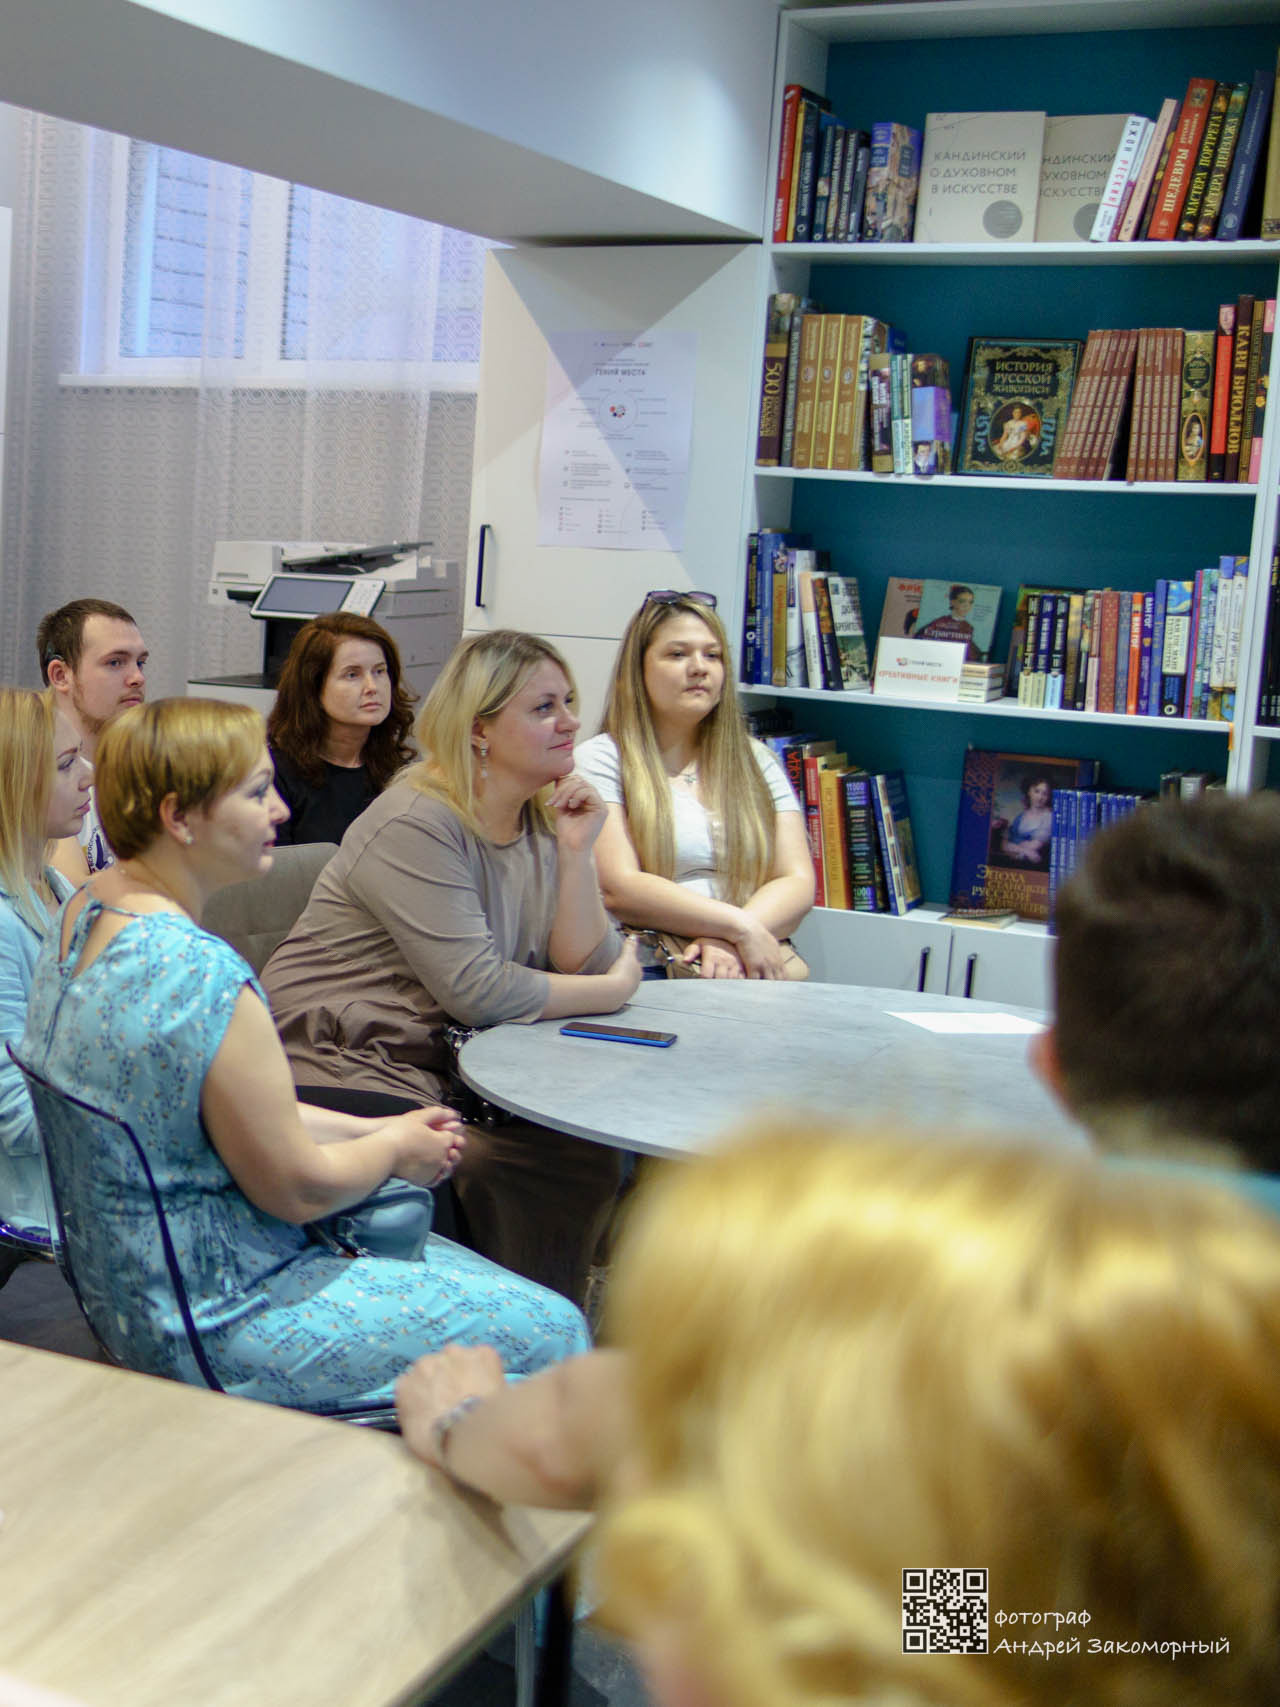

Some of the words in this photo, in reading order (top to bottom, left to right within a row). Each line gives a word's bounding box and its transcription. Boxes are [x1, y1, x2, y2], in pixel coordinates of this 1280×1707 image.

[1042, 150, 1116, 164] НДИНСКИЙ
[1186, 172, 1206, 216] МАСТЕРА
[1199, 115, 1222, 167] ПОРТРЕТА
[1204, 174, 1224, 218] МАСТЕРА
[1216, 117, 1239, 168] ПЕЙЗАЖА
[929, 168, 940, 177] О
[943, 168, 1016, 178] ДУХОВНОМ
[1041, 171, 1106, 181] УХОВНОМ
[1162, 148, 1189, 212] ШЕДЕВРЫ
[931, 184, 938, 194] В
[943, 184, 1018, 195] ИСКУССТВЕ
[1040, 187, 1106, 197] СКУССТВ
[1234, 325, 1250, 369] КАРЛ
[995, 361, 1053, 372] ИСТОРИЯ
[764, 362, 782, 395] 500
[994, 373, 1051, 384] РУССКОЙ
[992, 384, 1049, 394] ЖИВОПИСИ
[1228, 376, 1246, 454] БРЮЛЛОВ
[1145, 597, 1154, 613] ВАН
[1144, 614, 1153, 629] ГОГ
